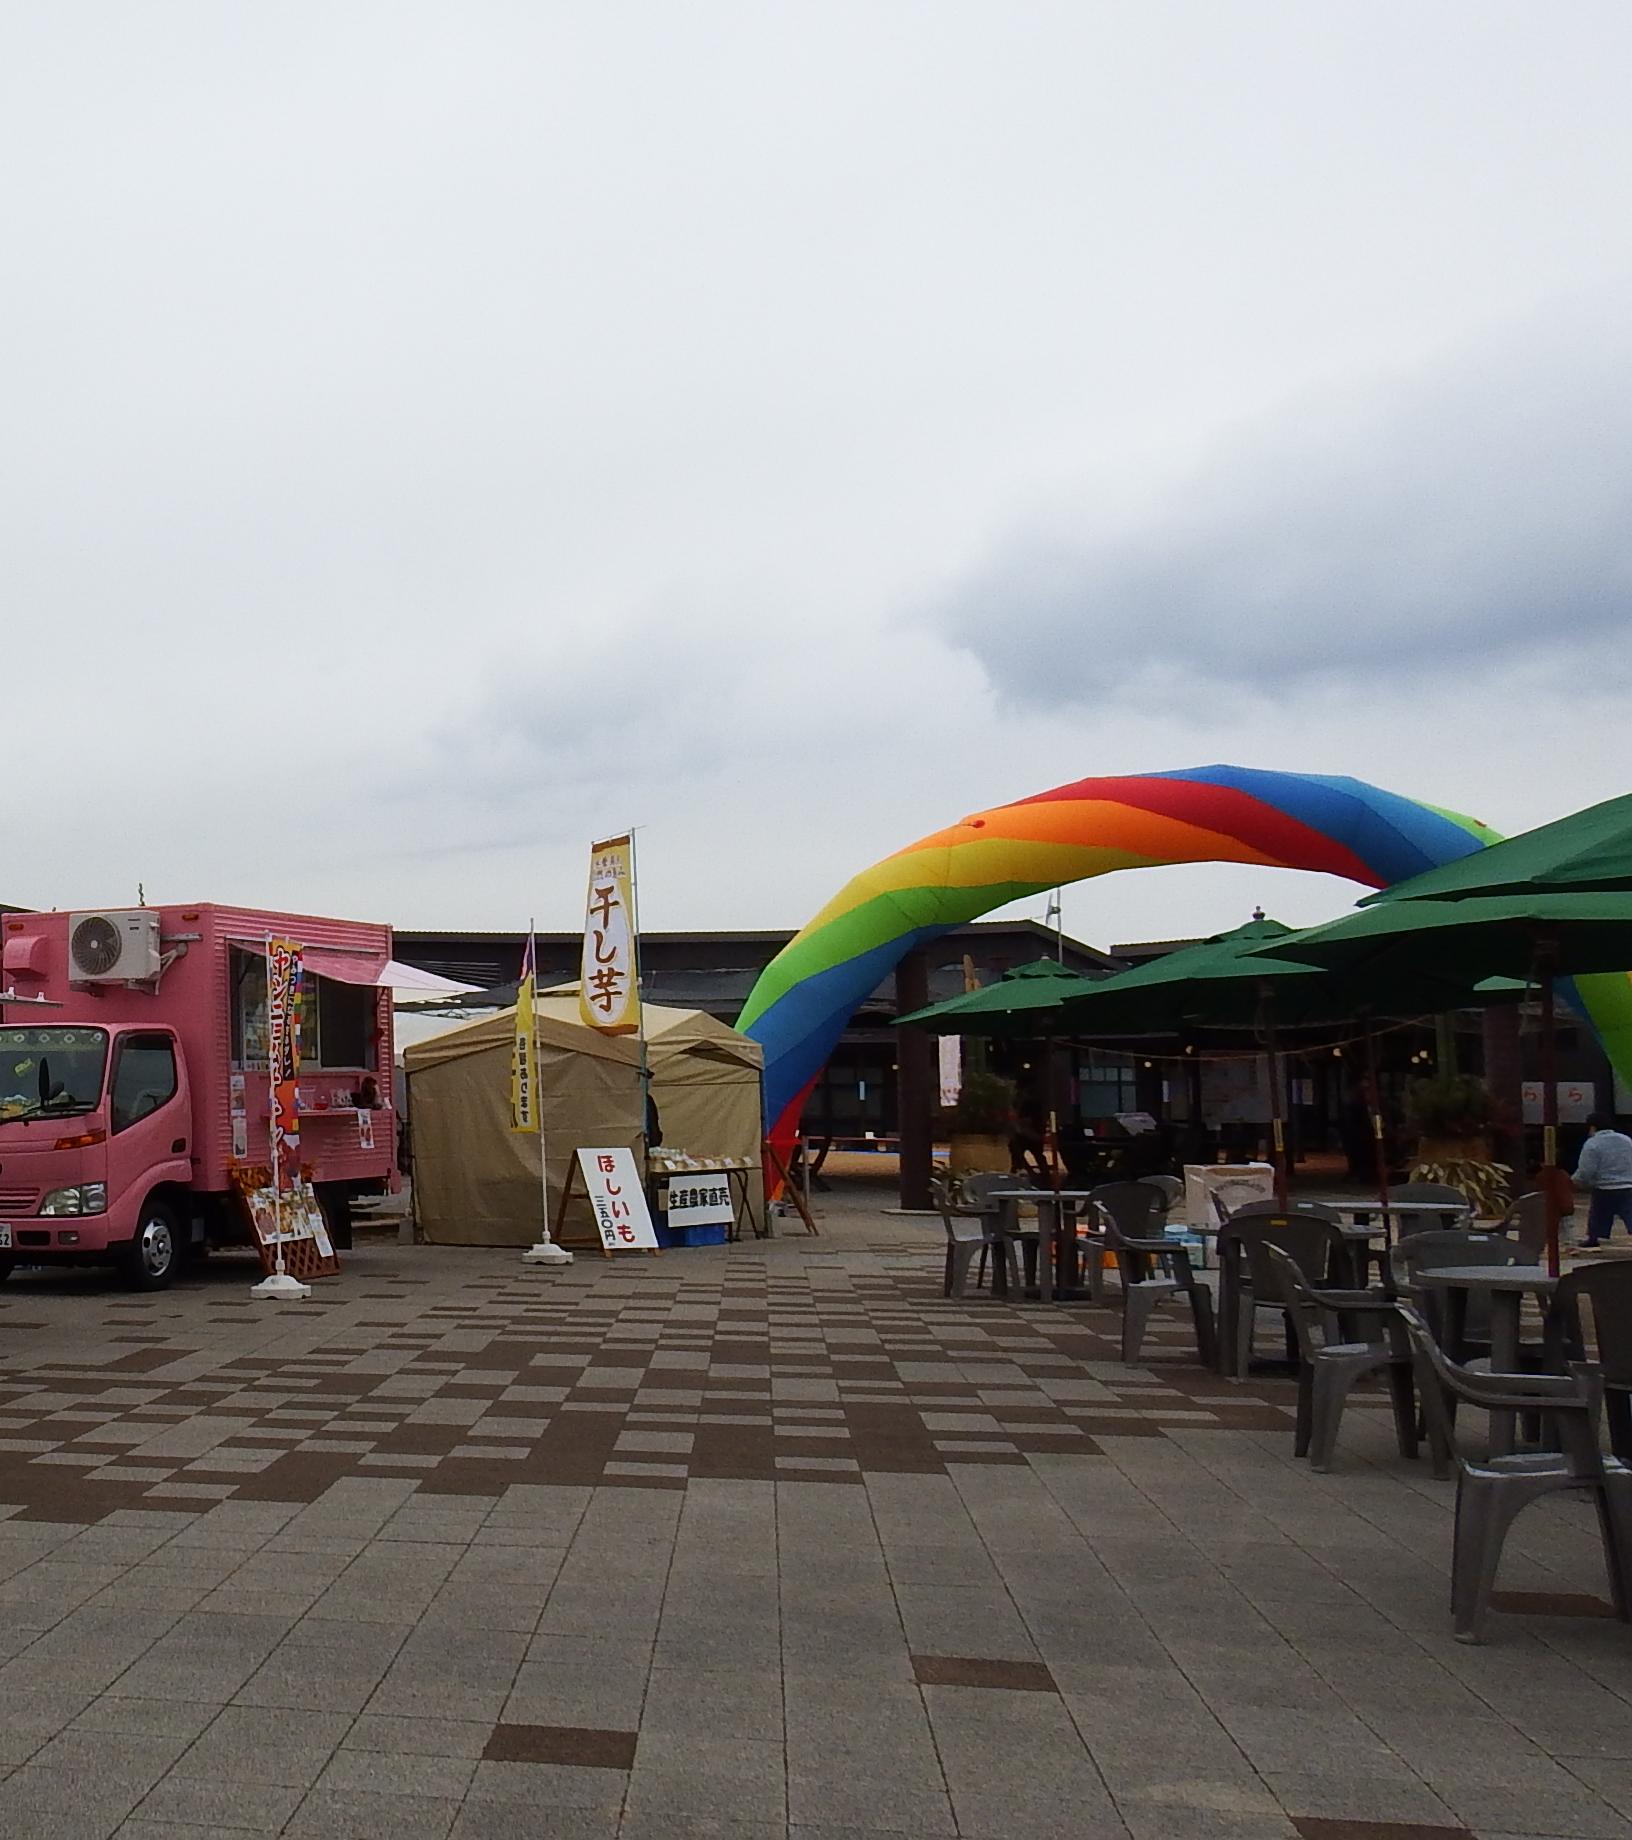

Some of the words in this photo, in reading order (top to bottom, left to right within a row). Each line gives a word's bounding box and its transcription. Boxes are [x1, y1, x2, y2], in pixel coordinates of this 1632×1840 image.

[589, 886, 625, 1012] 干し芋
[597, 1155, 636, 1243] ほしいも
